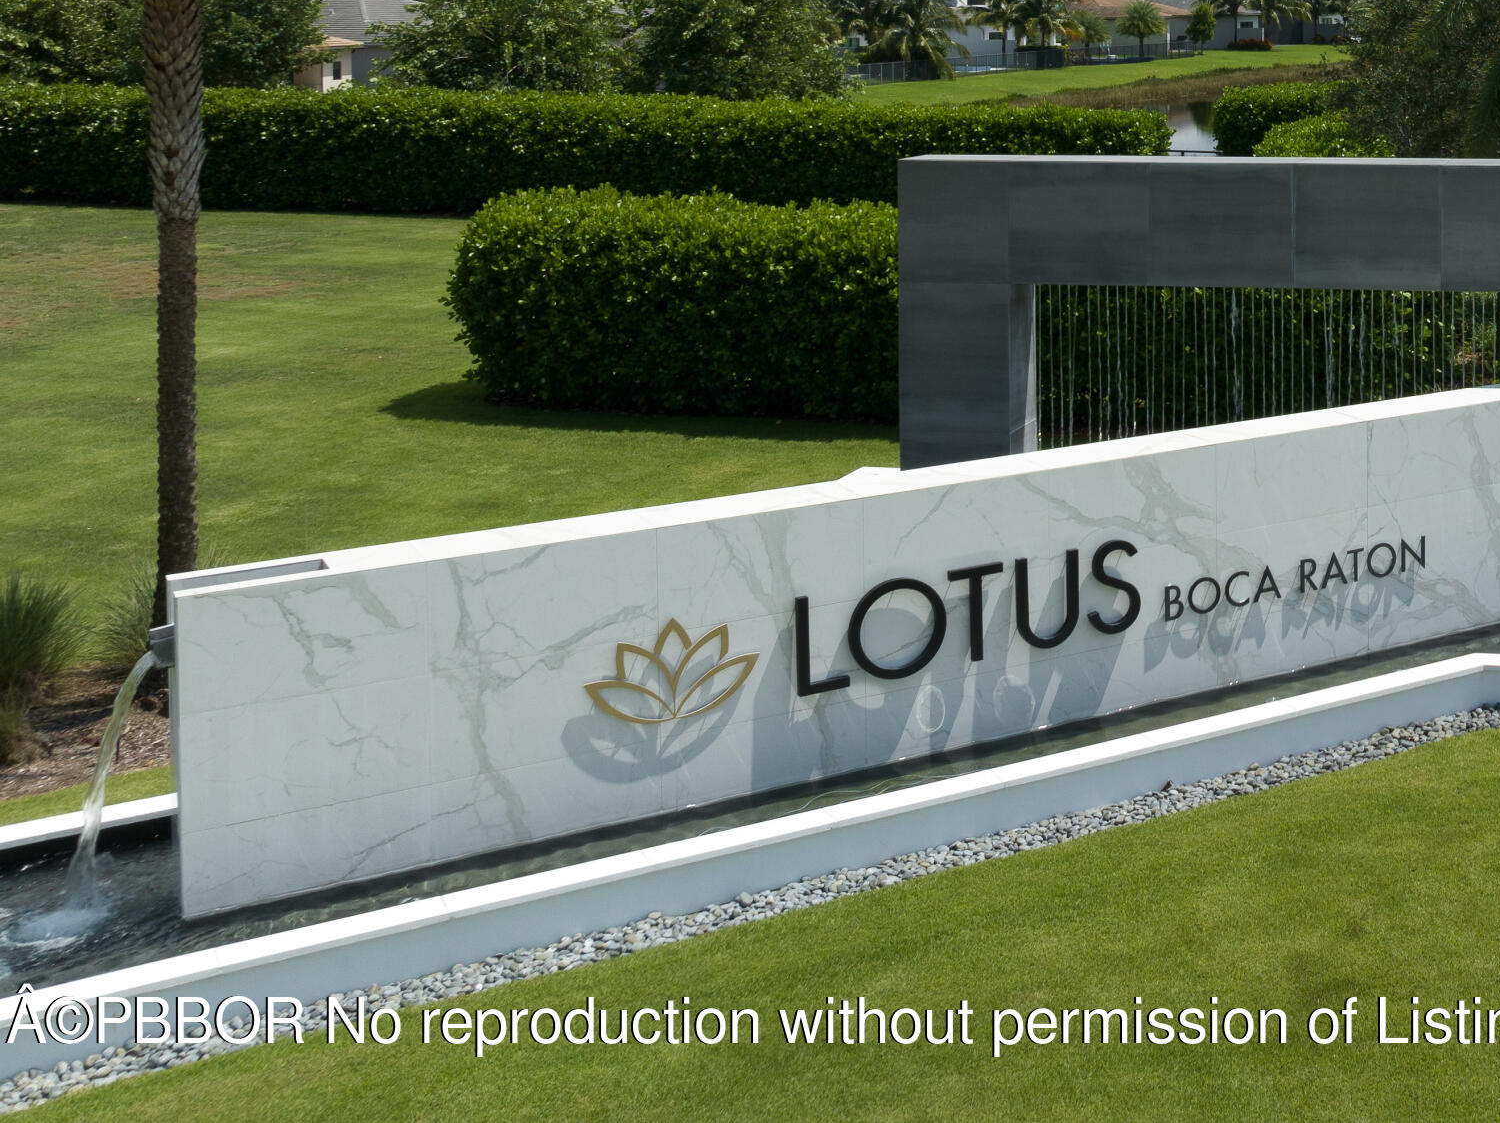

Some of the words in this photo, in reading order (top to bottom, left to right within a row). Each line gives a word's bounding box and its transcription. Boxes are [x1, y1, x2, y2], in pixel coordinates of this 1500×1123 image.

[794, 538, 1142, 697] LOTUS
[1163, 565, 1282, 622] BOCA
[1298, 535, 1428, 594] RATON
